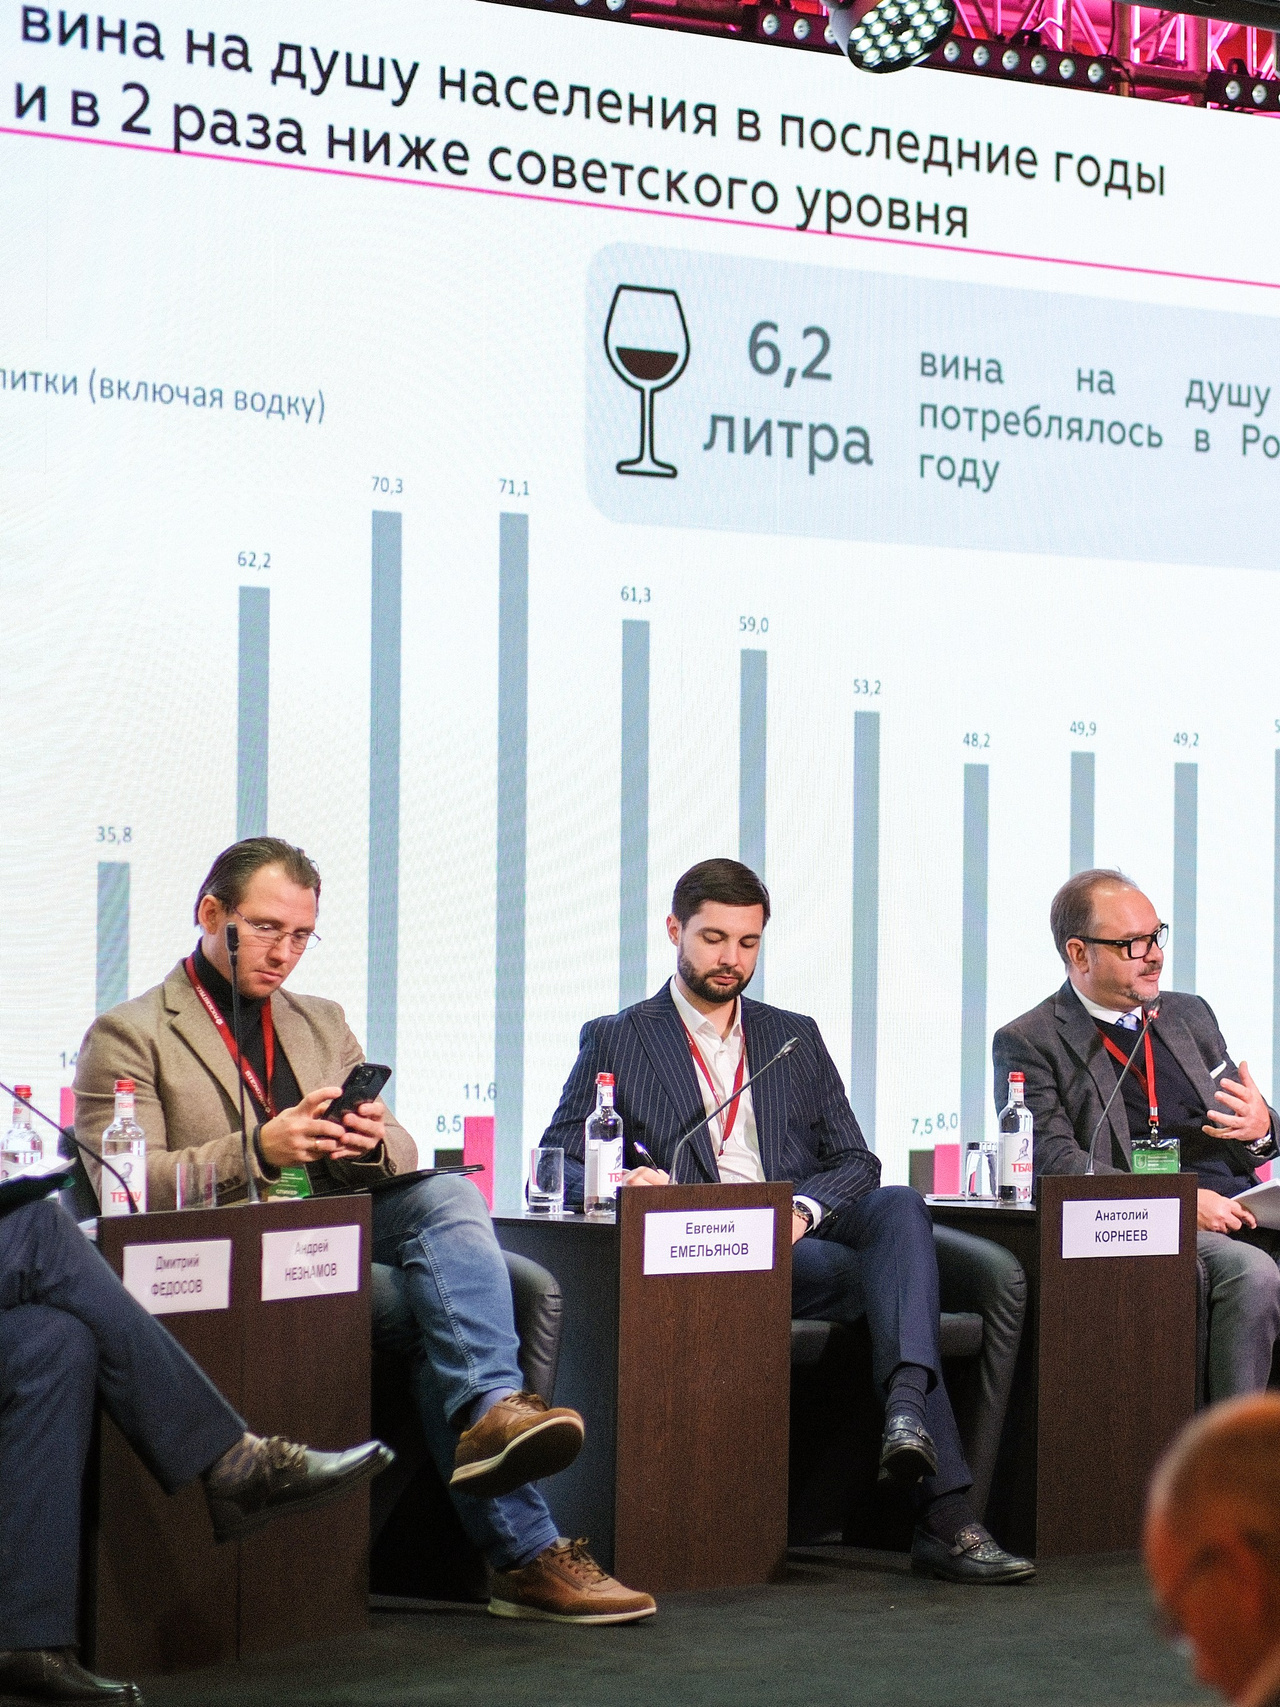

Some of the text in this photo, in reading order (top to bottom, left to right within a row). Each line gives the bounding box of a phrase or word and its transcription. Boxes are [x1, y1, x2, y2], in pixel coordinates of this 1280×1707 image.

[21, 5, 1164, 200] вина на душу населения в последние годы
[16, 82, 967, 238] и в 2 раза ниже советского уровня
[748, 320, 832, 388] 6,2
[921, 352, 1004, 384] вина
[1077, 368, 1115, 395] на
[1185, 379, 1271, 418] душу
[89, 368, 223, 408] (включая
[235, 390, 325, 424] водку)
[920, 403, 1163, 448] потреблялось
[1195, 429, 1210, 452] в
[703, 414, 873, 475] литра
[920, 454, 1000, 493] году
[370, 474, 405, 497] 70,3
[497, 476, 531, 499] 71,1
[236, 550, 272, 572] 62,2
[619, 584, 653, 606] 61,3
[739, 615, 770, 635] 59,0
[853, 678, 882, 696] 53,2
[1069, 720, 1097, 738] 49,9
[1172, 731, 1200, 747] 49,2
[962, 732, 991, 748] 48,2
[96, 825, 133, 845] 35,8
[463, 1081, 499, 1103] 11,6
[435, 1114, 462, 1135] 8,5
[910, 1116, 934, 1137] 7,5
[935, 1111, 959, 1132] 8,0
[1094, 1208, 1149, 1222] Анатолий
[686, 1219, 735, 1237] Евгений
[1094, 1229, 1149, 1243] КОРНЕЕВ
[294, 1238, 329, 1258] Андрей
[669, 1241, 749, 1260] ЕМЕЛЬЯНОВ
[155, 1253, 200, 1273] Дмитрий
[284, 1262, 338, 1282] НЕЗНАМОВ
[150, 1278, 203, 1298] ФЕДОСОВ
